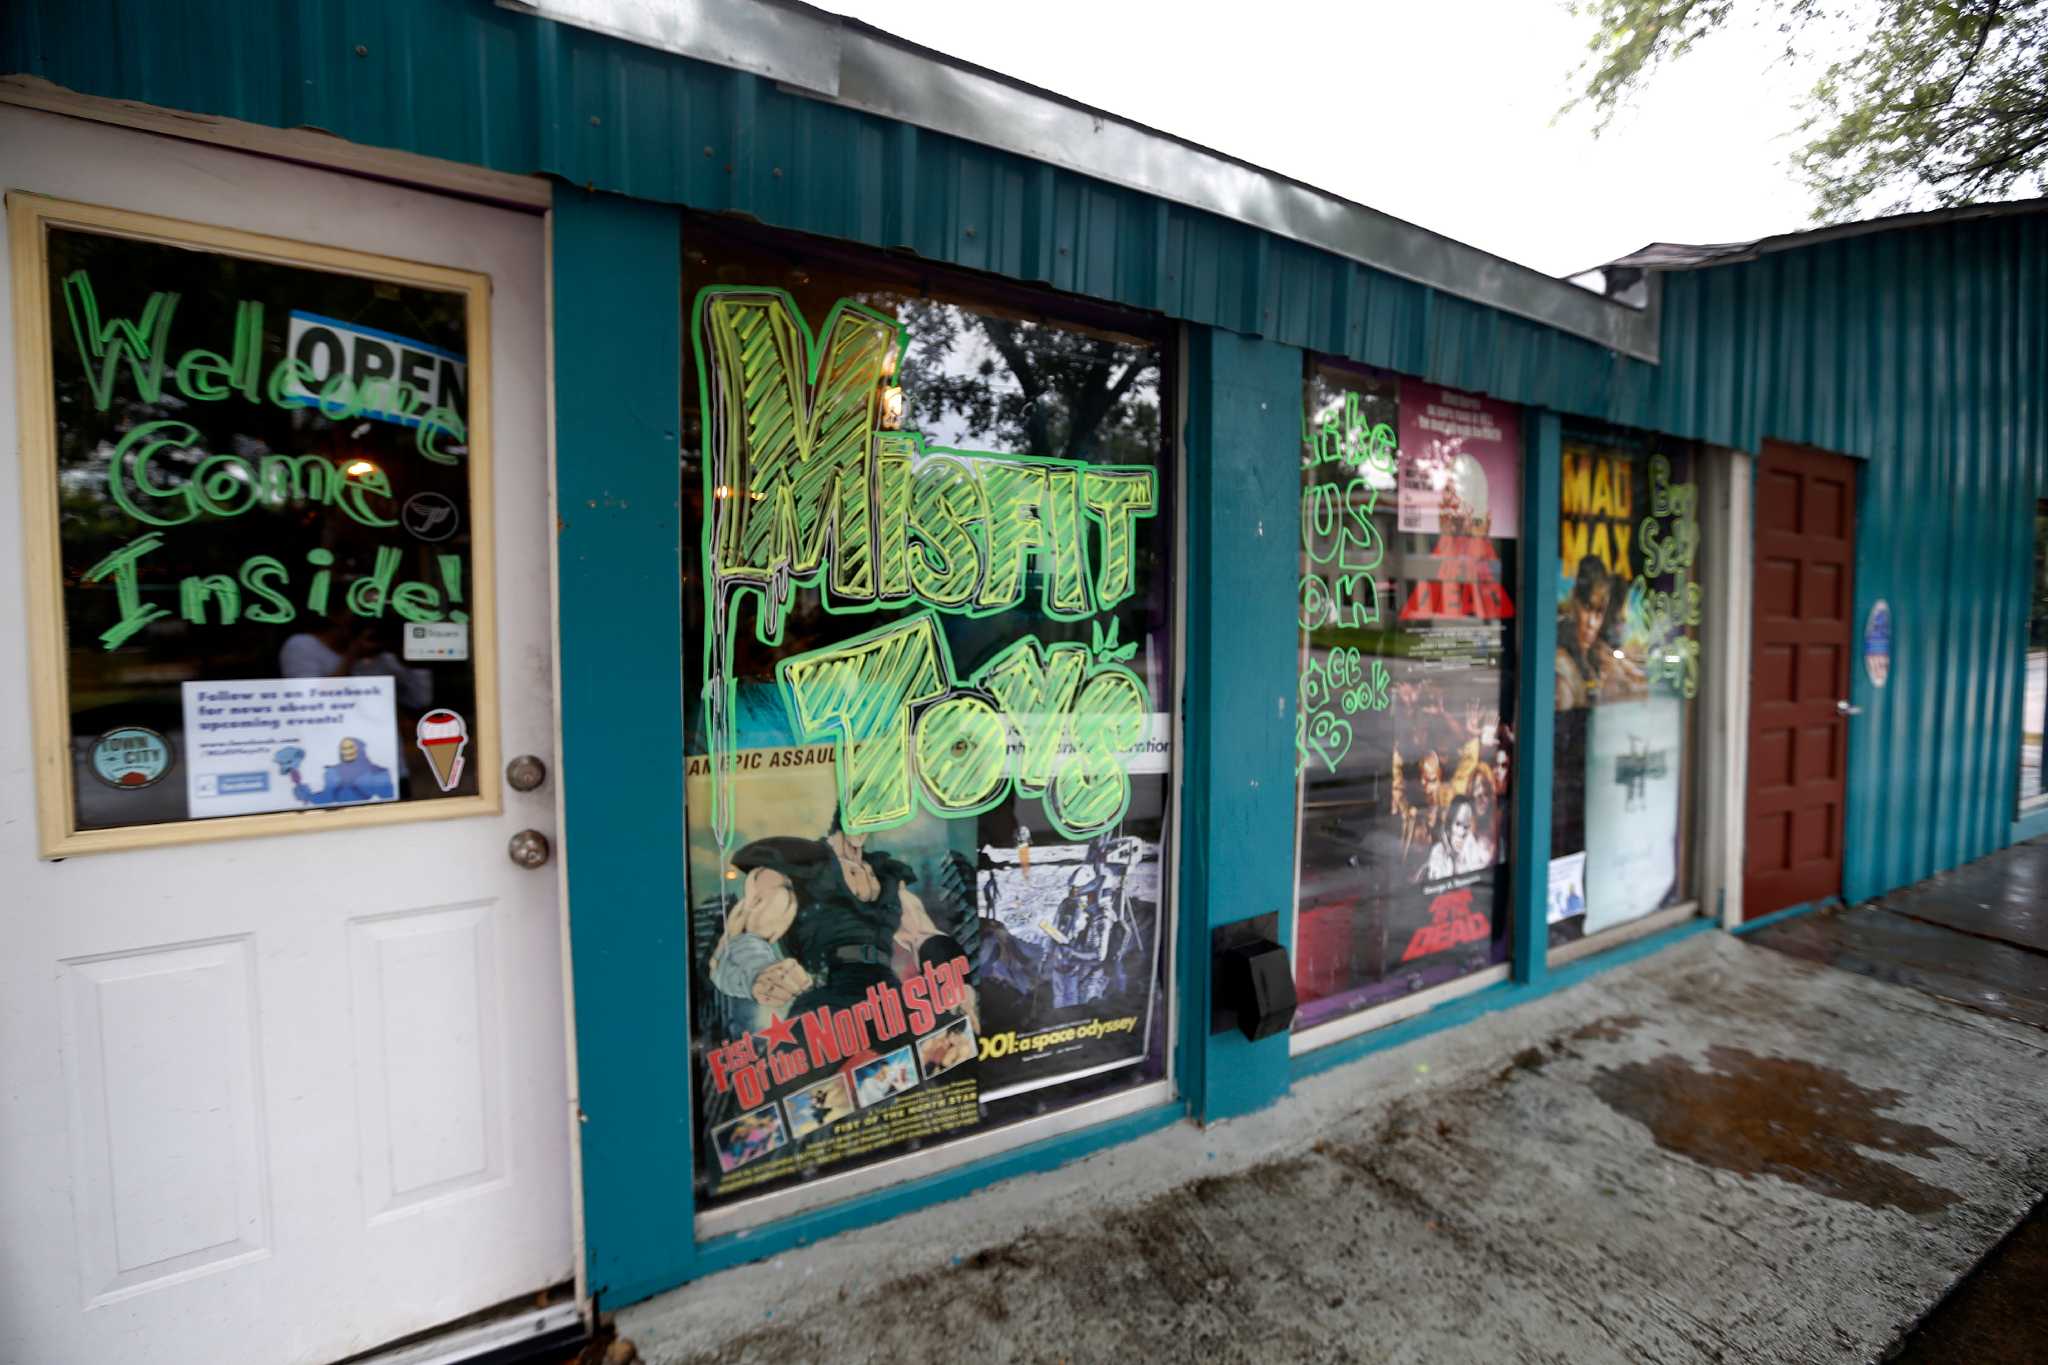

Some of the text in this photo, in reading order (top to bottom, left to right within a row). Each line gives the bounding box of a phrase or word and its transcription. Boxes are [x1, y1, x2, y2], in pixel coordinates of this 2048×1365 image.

[63, 269, 469, 465] Welcome
[296, 327, 466, 424] OPEN
[1562, 451, 1634, 518] MAD
[1562, 519, 1635, 582] MAX
[82, 532, 469, 651] Inside!
[197, 691, 254, 702] Follow
[260, 691, 277, 700] us
[309, 686, 381, 697] Facebook
[198, 705, 224, 716] for
[230, 704, 272, 714] news
[200, 717, 280, 731] upcoming
[770, 746, 847, 768] ASSAUL
[767, 1046, 809, 1086] the
[800, 981, 907, 1069] North
[902, 955, 971, 1036] Star
[1020, 1037, 1031, 1052] a
[1032, 1027, 1076, 1053] space
[1076, 1017, 1138, 1040] odyssey
[707, 1031, 758, 1095] Fist
